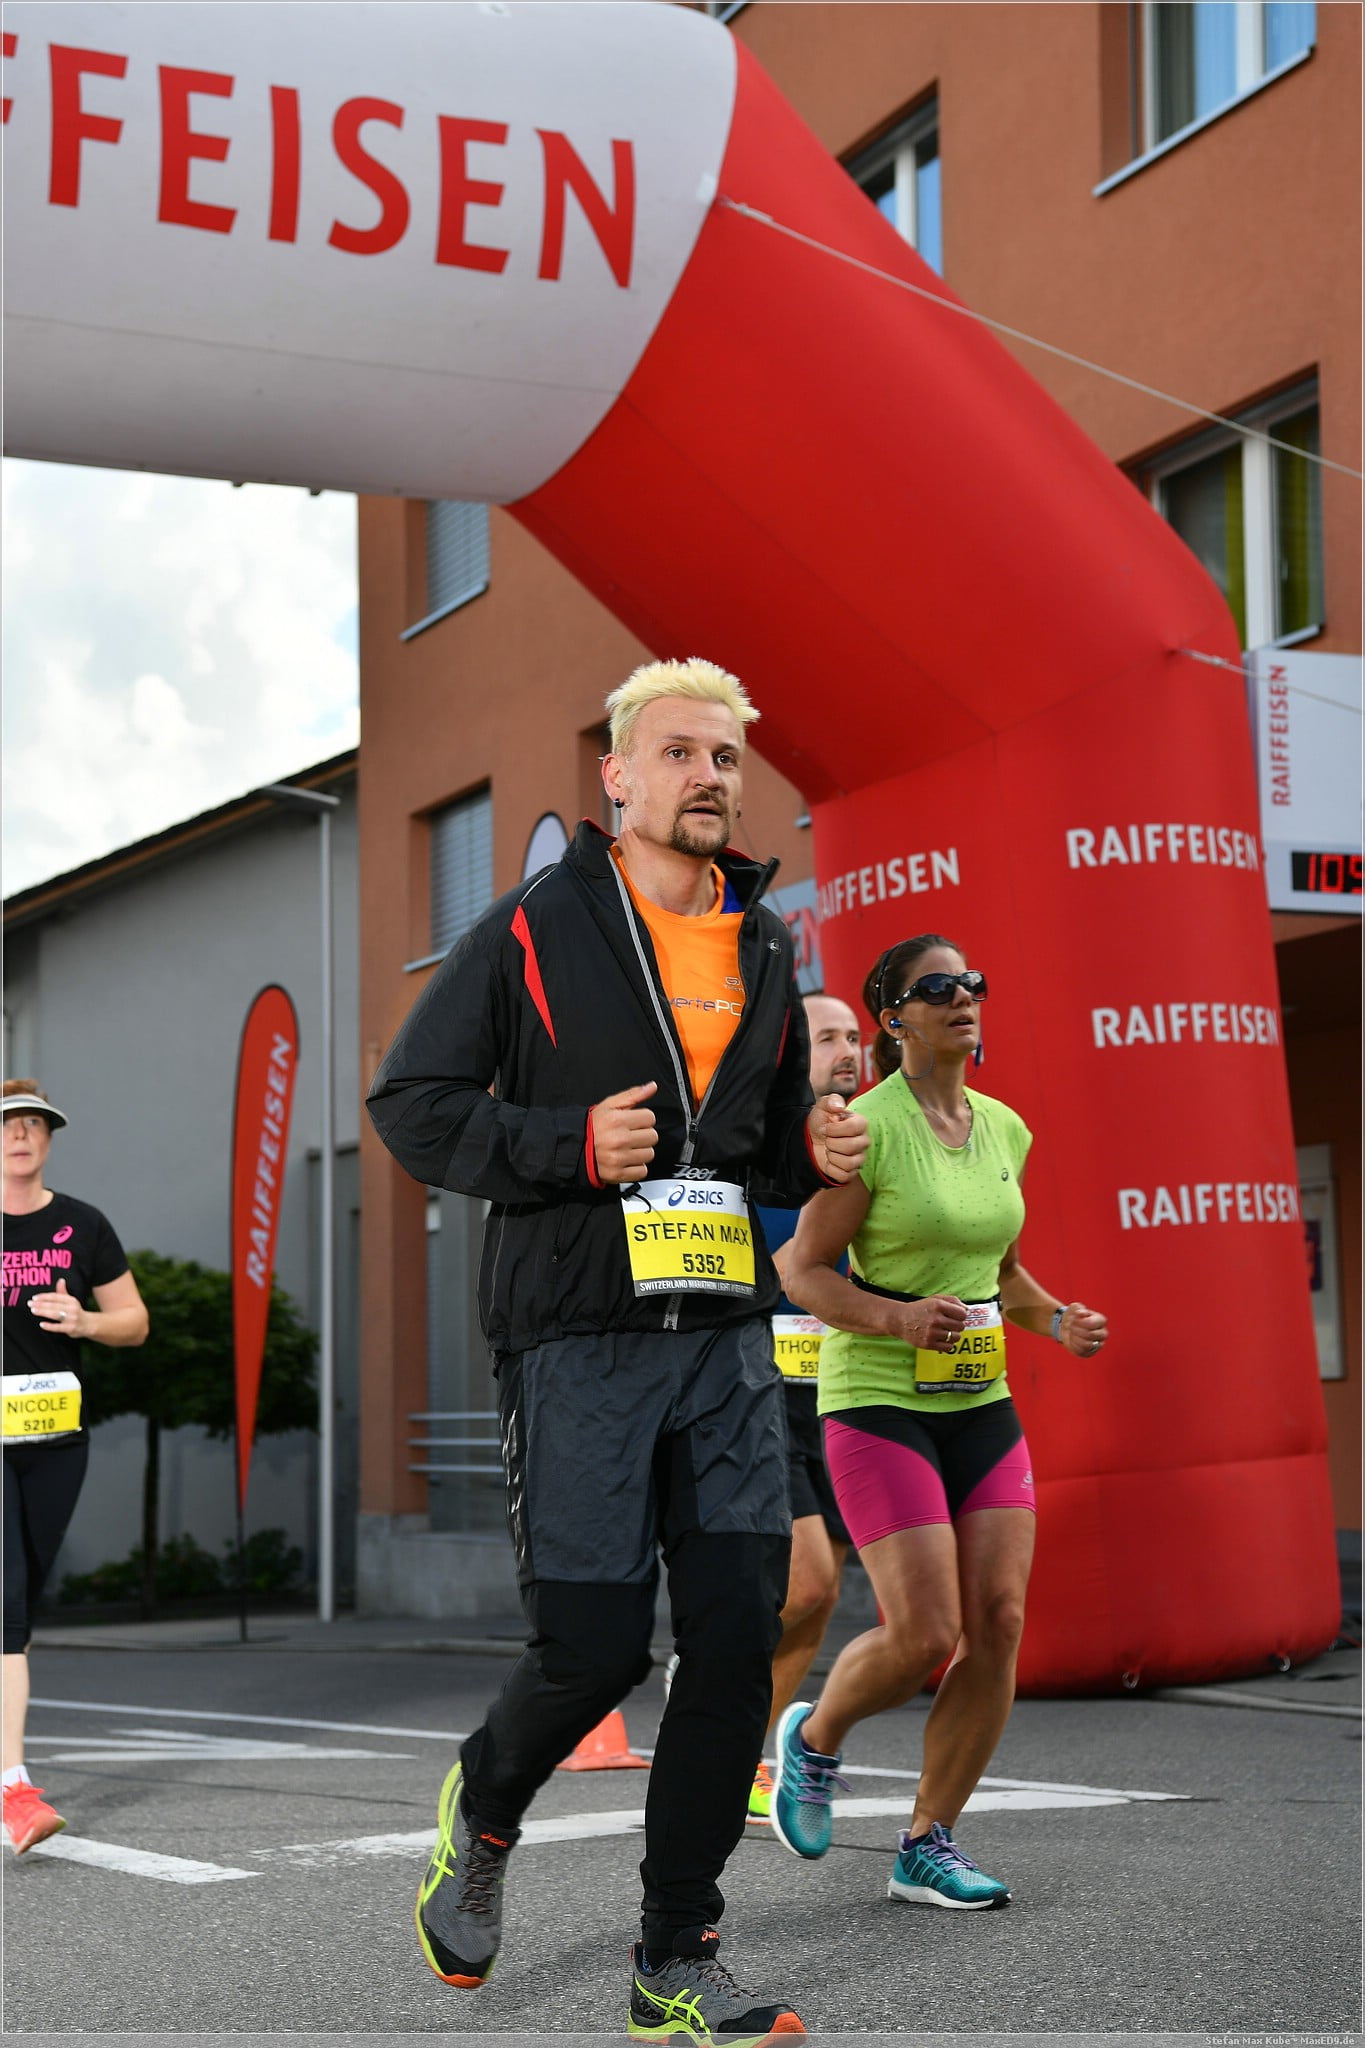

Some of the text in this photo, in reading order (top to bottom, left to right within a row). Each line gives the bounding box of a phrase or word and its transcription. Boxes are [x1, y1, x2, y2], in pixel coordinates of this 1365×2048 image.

[0, 32, 636, 291] FEISEN
[1268, 665, 1292, 807] RAIFFEISEN
[1065, 823, 1260, 870] RAIFFEISEN
[1091, 1002, 1280, 1049] RAIFFEISEN
[246, 1031, 292, 1289] RAIFFEISEN
[687, 1189, 724, 1205] asics
[1117, 1182, 1300, 1231] RAIFFEISEN
[633, 1221, 750, 1247] STEFAN MAX
[0, 1248, 72, 1270] ZERLAND
[682, 1253, 727, 1276] 5352
[639, 1279, 689, 1293] SWITZERLAND
[953, 1361, 987, 1380] 5521
[7, 1396, 69, 1415] NICOLE
